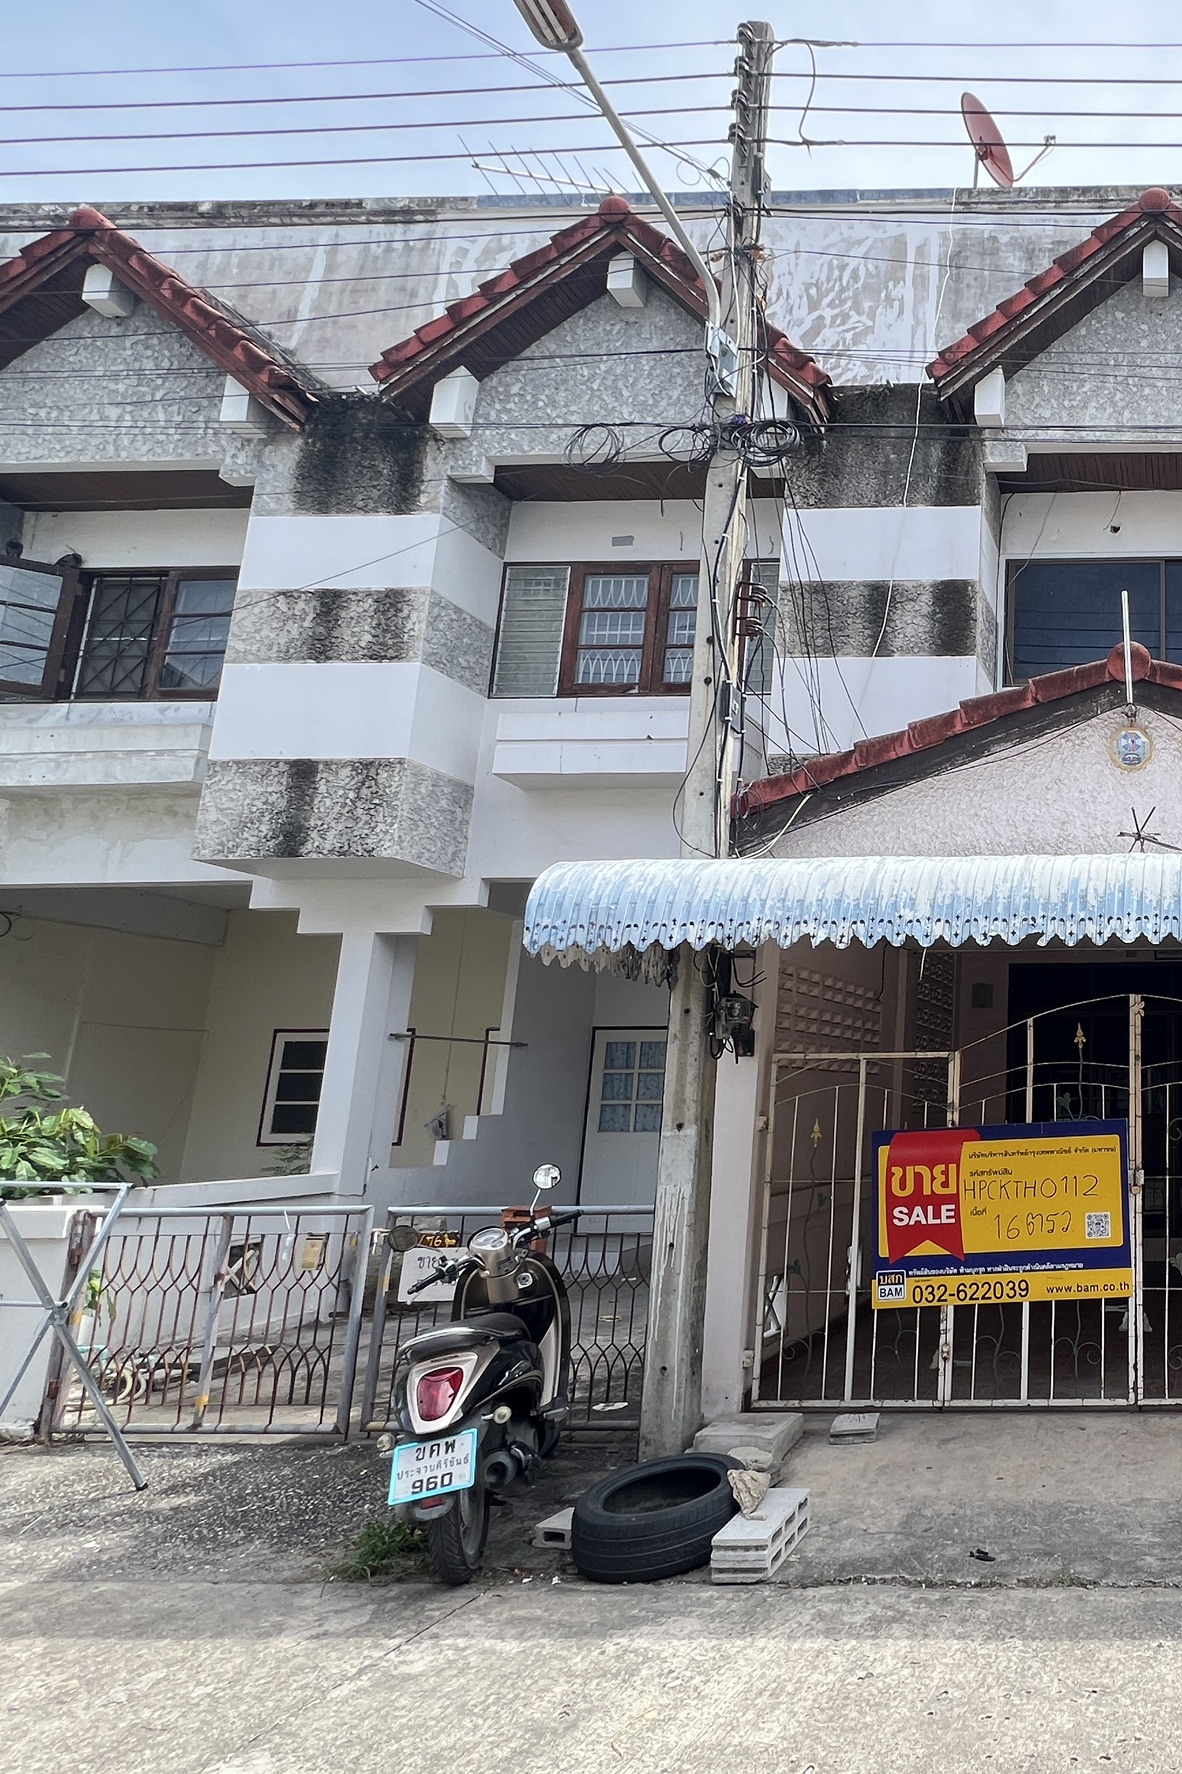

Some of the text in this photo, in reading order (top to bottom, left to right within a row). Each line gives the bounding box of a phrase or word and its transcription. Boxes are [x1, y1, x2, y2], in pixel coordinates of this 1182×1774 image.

[891, 1163, 957, 1197] ขาย
[892, 1204, 956, 1227] SALE
[994, 1214, 1020, 1240] 16
[879, 1273, 903, 1285] บสก
[1046, 1281, 1130, 1294] www.bam.co.th
[879, 1288, 903, 1298] BAM
[912, 1279, 1030, 1304] 032-622039
[397, 1453, 469, 1480] ประจวบคีรีขันธ์
[411, 1472, 453, 1495] 960
